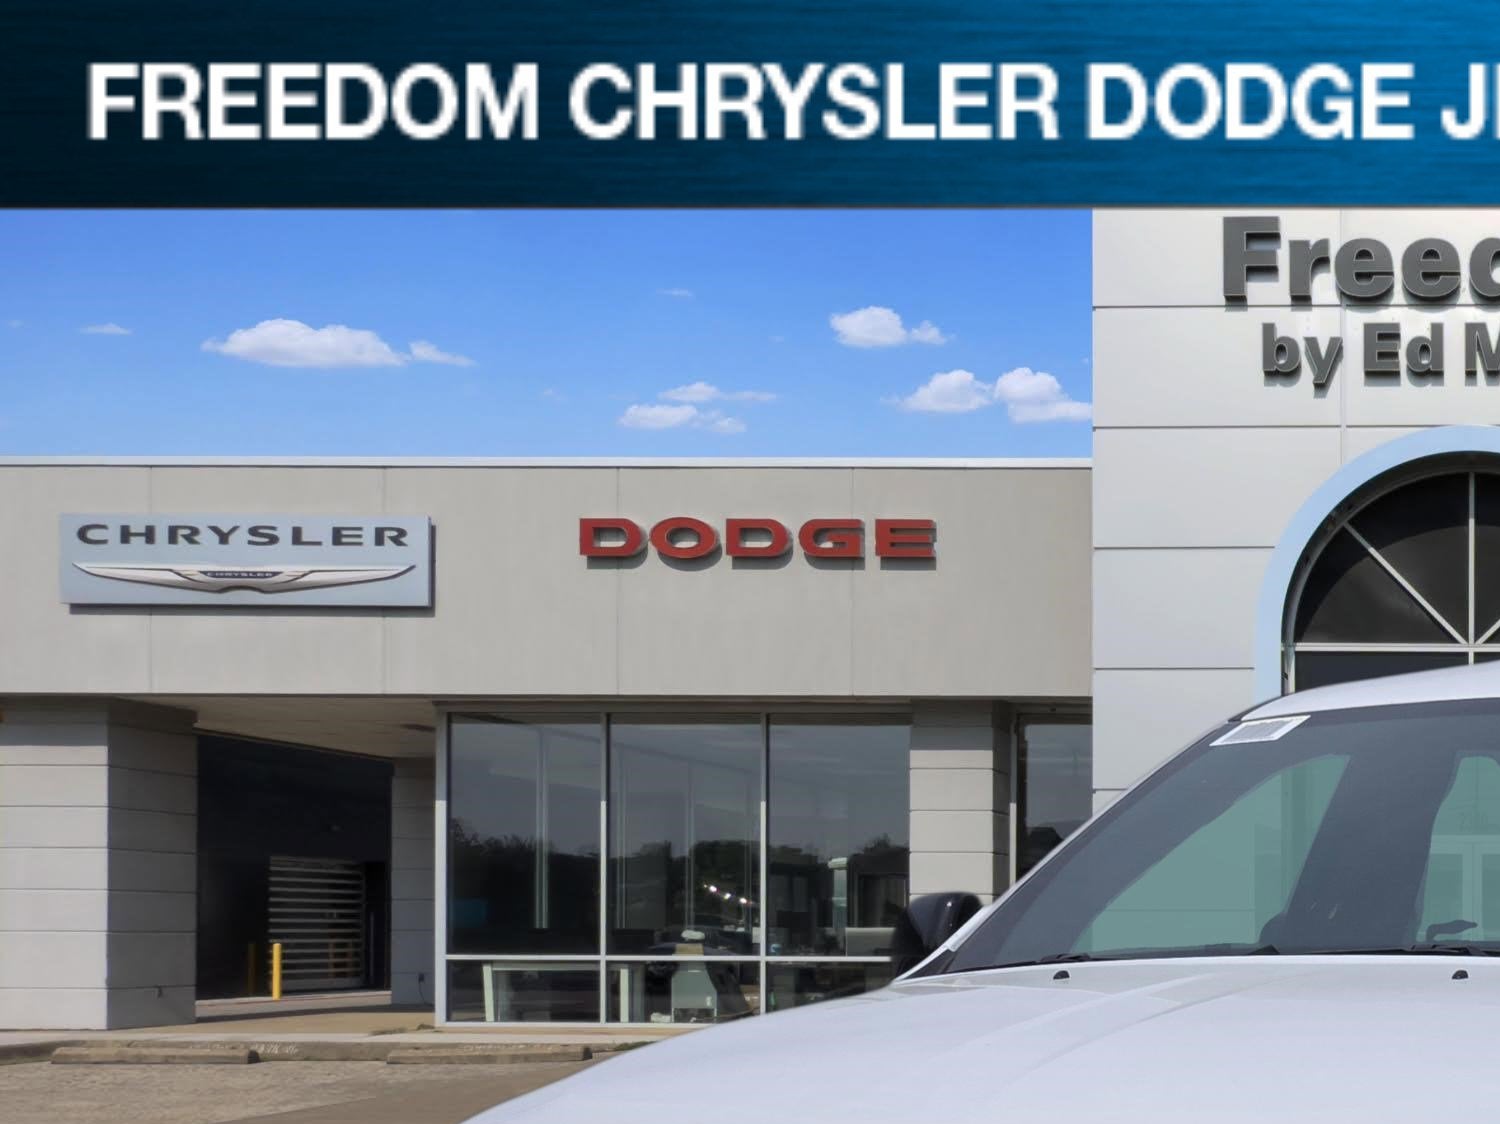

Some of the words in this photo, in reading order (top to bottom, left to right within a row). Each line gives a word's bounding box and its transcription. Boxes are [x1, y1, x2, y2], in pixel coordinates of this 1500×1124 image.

[1261, 322, 1343, 388] by
[1363, 322, 1445, 378] Ed
[76, 523, 408, 547] CHRYSLER
[579, 516, 938, 560] DODGE
